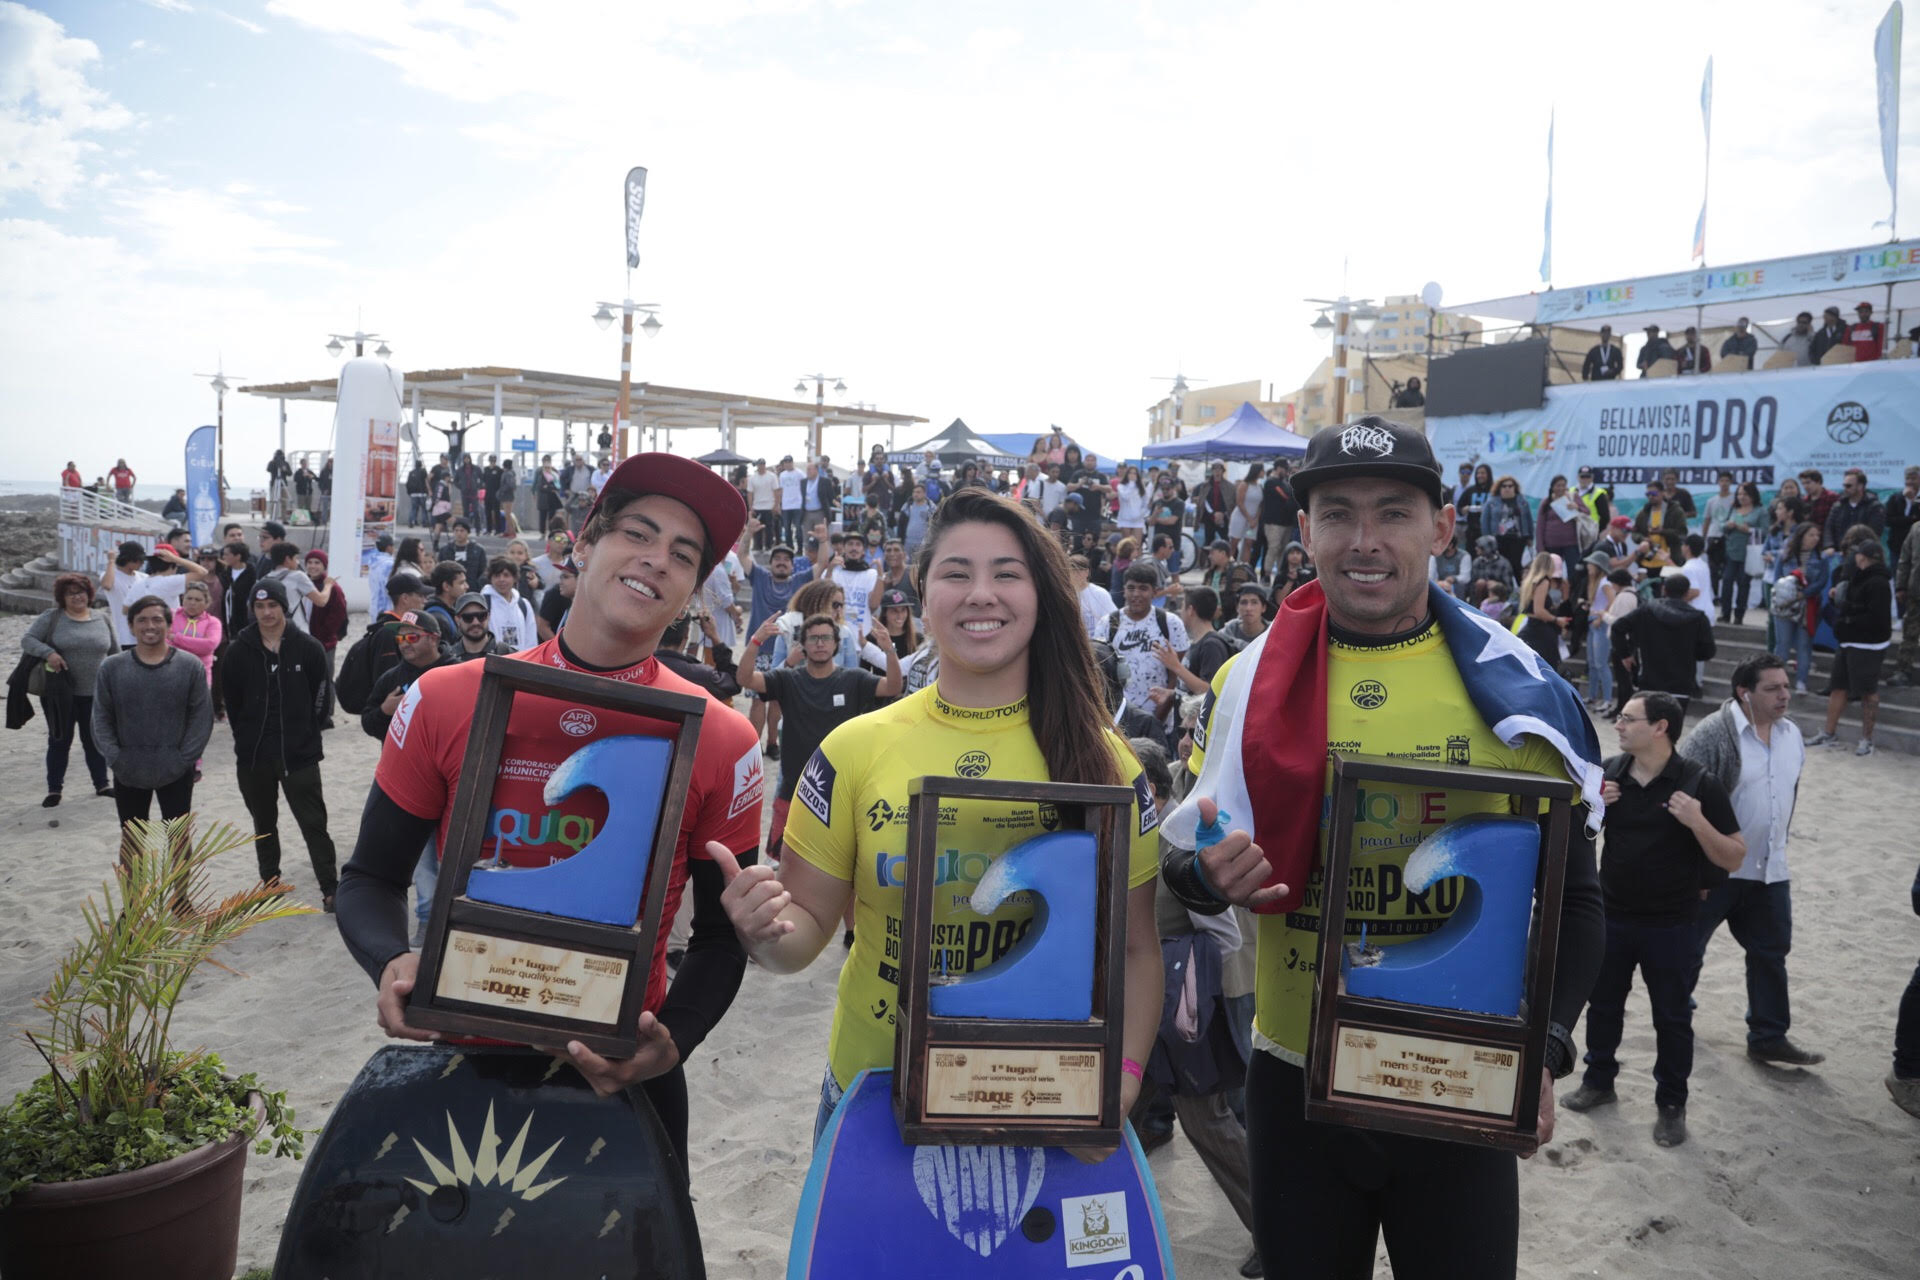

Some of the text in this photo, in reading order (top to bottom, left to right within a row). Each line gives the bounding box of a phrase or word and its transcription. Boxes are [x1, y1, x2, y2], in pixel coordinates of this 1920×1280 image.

[1600, 404, 1691, 430] BELLAVISTA
[1832, 406, 1863, 420] APB
[1693, 396, 1778, 460] PRO
[1337, 424, 1397, 458] ERIZOS
[1598, 433, 1692, 457] BODYBOARD
[1357, 684, 1381, 693] APB
[935, 697, 1025, 720] APB WORLD TOUR
[567, 712, 592, 723] APB
[505, 758, 561, 770] CORPORACIÓ
[962, 755, 985, 763] APB
[504, 766, 553, 778] MUNICIP
[983, 816, 1034, 824] Municipalidad
[526, 959, 560, 973] lugar
[488, 965, 518, 977] junior
[518, 970, 551, 984] qualify
[552, 975, 577, 986] series
[1079, 1055, 1095, 1068] PRO
[1416, 1053, 1450, 1065] lugar
[1495, 1053, 1513, 1067] PRO
[1006, 1064, 1038, 1074] lugar
[1380, 1060, 1409, 1070] mens
[1412, 1063, 1418, 1072] 5
[1422, 1064, 1443, 1076] star
[1071, 1236, 1125, 1252] KINGDOM
